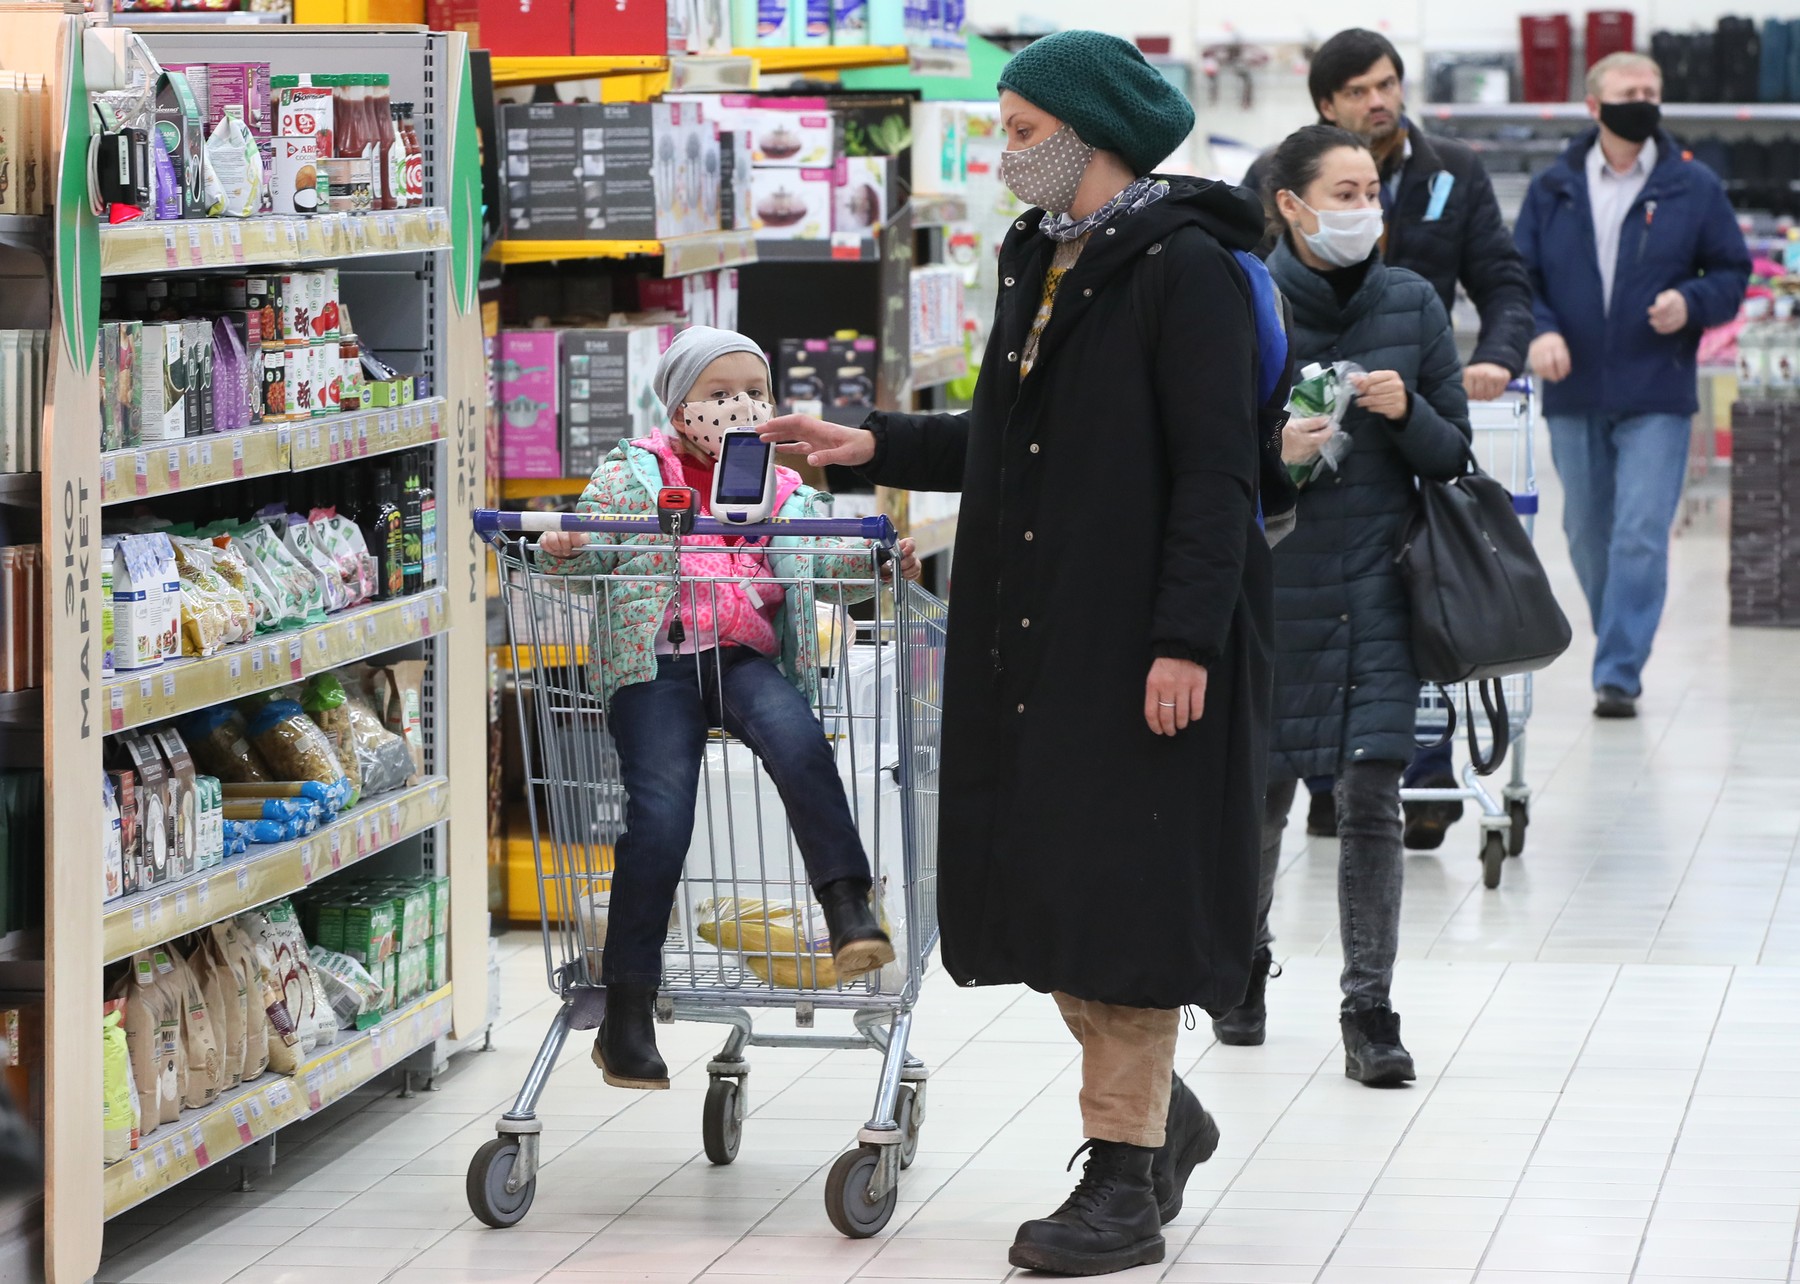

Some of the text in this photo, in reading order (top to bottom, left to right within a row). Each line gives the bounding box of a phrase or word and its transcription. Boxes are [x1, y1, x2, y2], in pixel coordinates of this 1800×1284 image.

[457, 399, 465, 506] ЭКО
[468, 396, 476, 603] МАРКЕТ
[64, 479, 75, 618] ЭКО
[78, 476, 90, 740] МАРКЕТ
